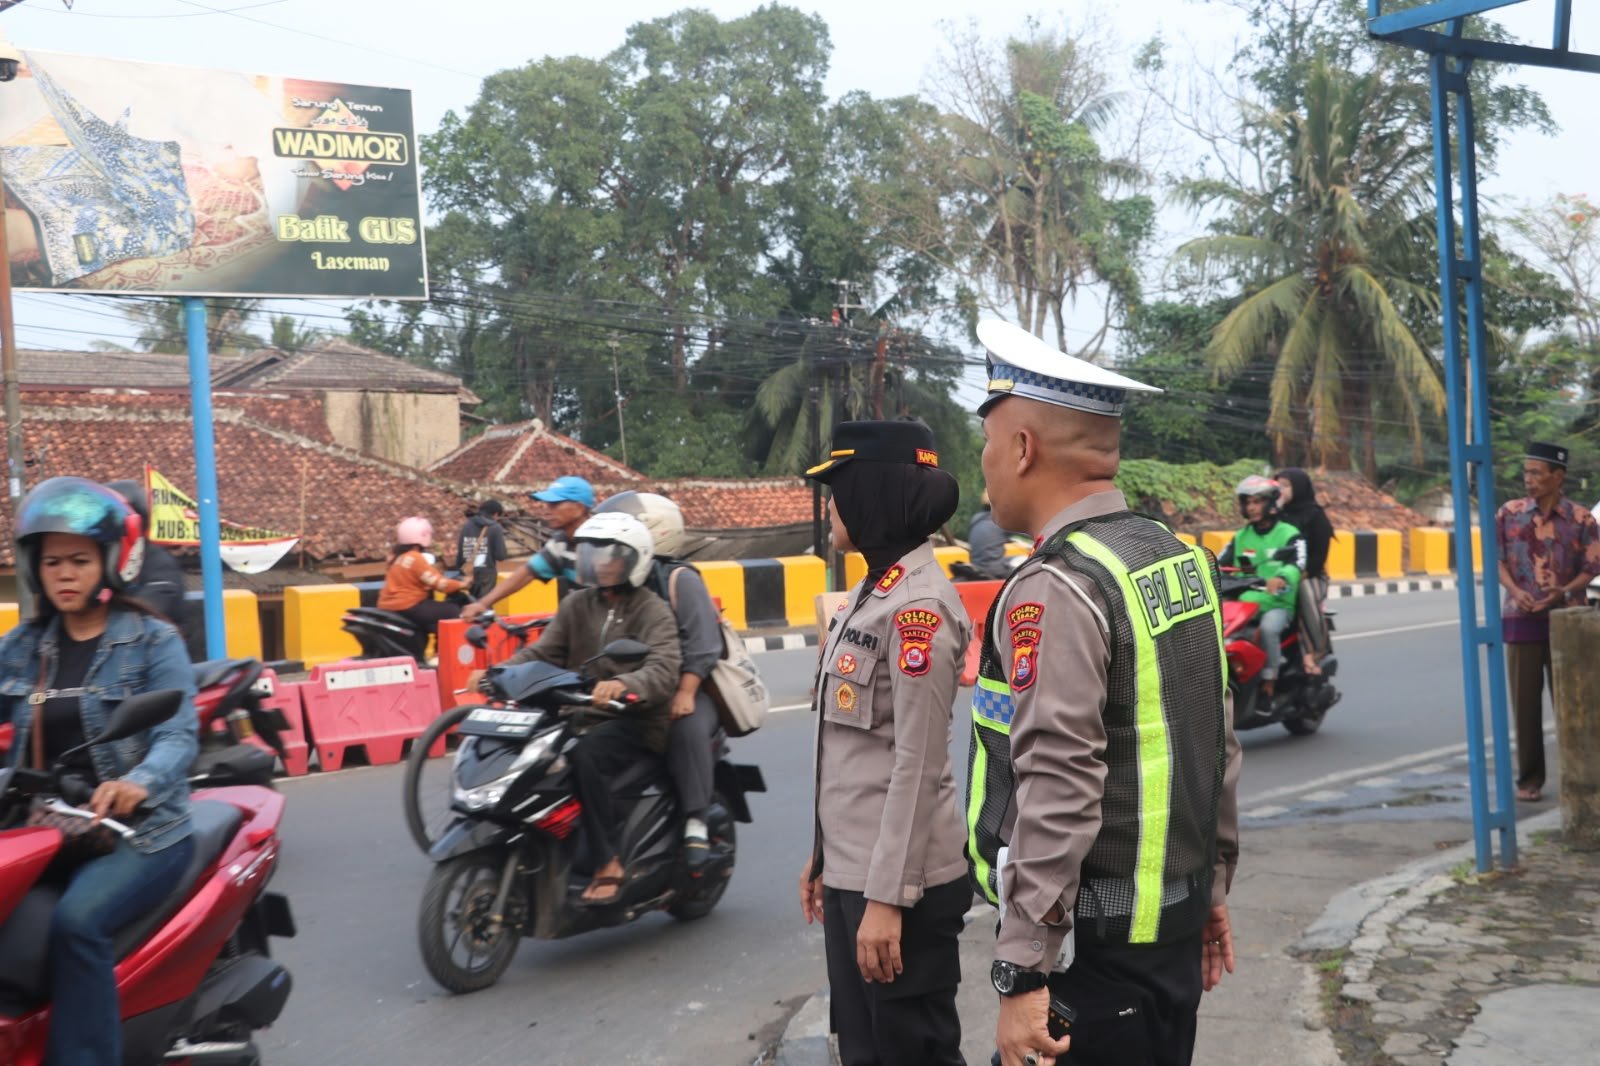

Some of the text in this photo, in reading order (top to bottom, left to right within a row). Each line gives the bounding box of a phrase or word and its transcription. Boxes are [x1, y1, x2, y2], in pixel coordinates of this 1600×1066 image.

[346, 101, 383, 113] Tenun
[275, 130, 401, 161] WADIMOR
[277, 214, 417, 244] Batik GUS
[311, 251, 390, 272] Laseman
[1135, 558, 1210, 629] POLISI
[897, 610, 938, 624] POLRES
[1011, 605, 1039, 620] POLRES
[901, 616, 934, 627] LEBAK
[903, 630, 930, 638] BANTEN
[1013, 630, 1037, 642] BANTEN
